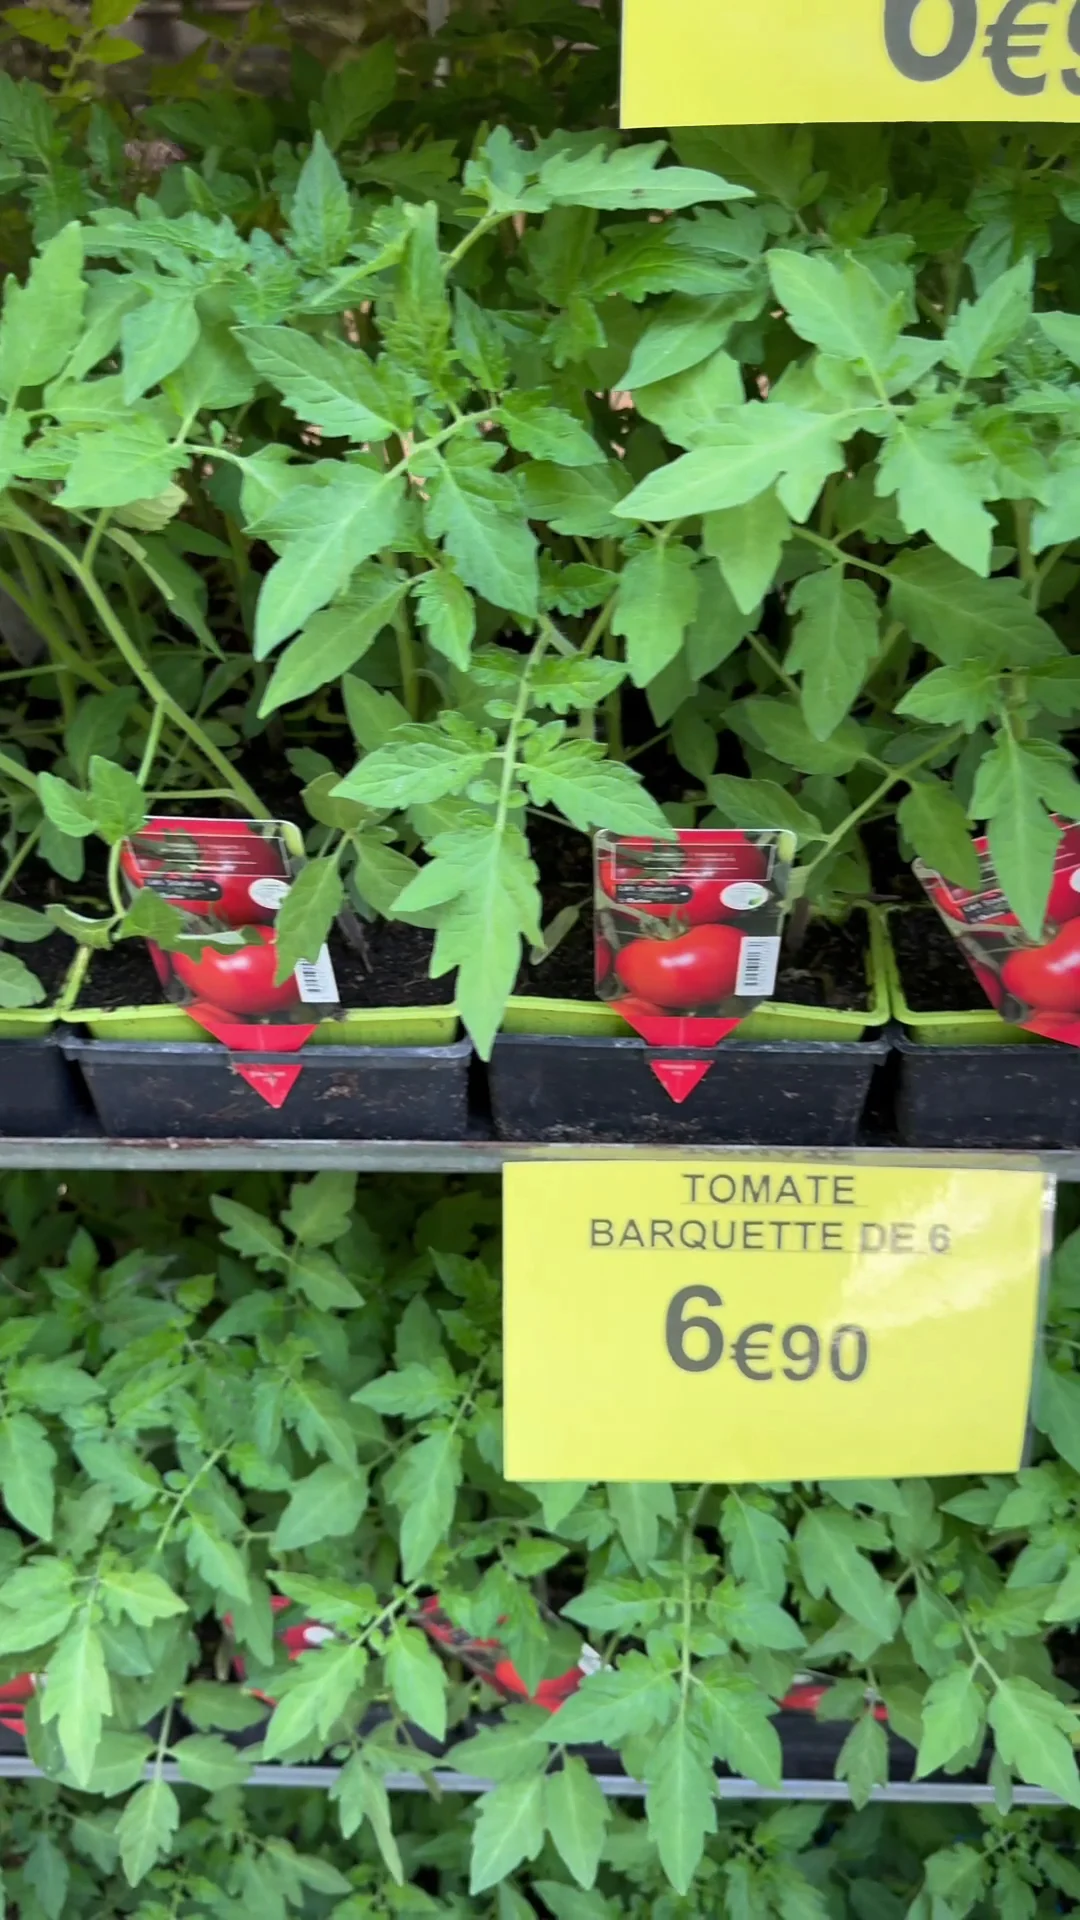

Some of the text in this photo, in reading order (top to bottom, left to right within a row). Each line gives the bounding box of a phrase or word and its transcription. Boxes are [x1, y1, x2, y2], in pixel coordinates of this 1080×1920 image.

[683, 1174, 855, 1204] TOMATE
[590, 1219, 951, 1253] BARQUETTE DE 6
[665, 1284, 868, 1382] 6€90
